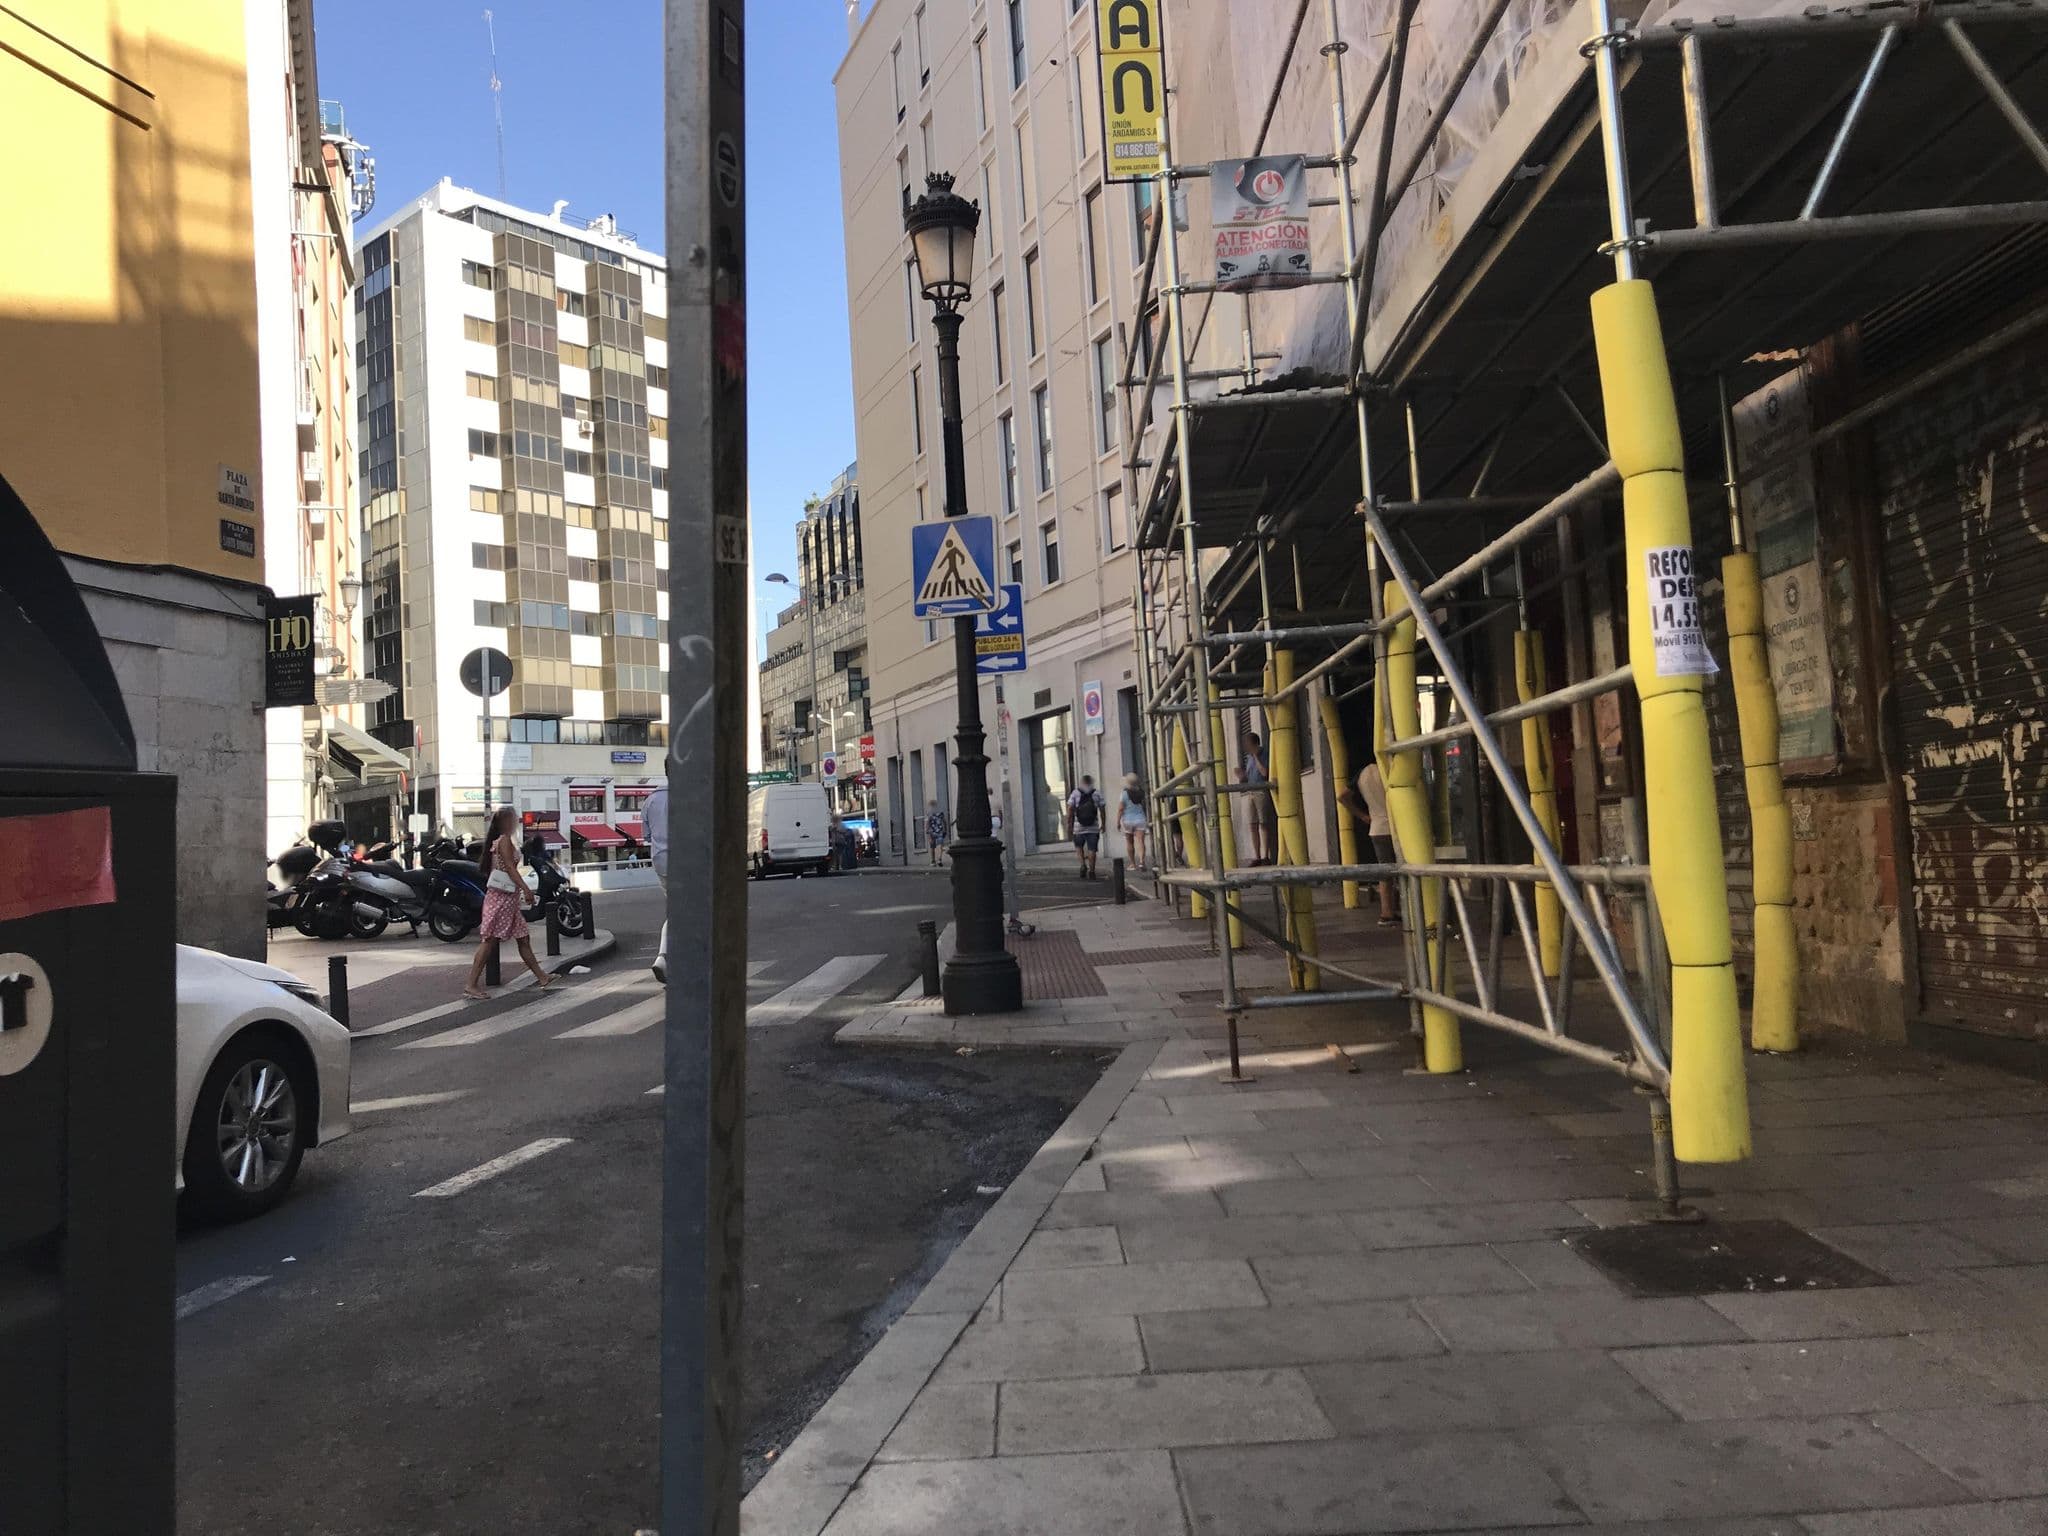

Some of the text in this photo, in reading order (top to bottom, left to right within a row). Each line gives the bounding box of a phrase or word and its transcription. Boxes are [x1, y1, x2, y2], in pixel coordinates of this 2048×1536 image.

[1112, 119, 1132, 129] UNIÓN
[1112, 127, 1145, 138] ANDAMIOS
[1216, 221, 1308, 246] ATENCIÓN
[1216, 239, 1309, 258] ALARMA CONECTADA
[226, 469, 248, 486] PLAZA
[1648, 548, 1695, 578] REFO
[271, 650, 307, 660] SHISHAS
[574, 815, 599, 823] BURGER
